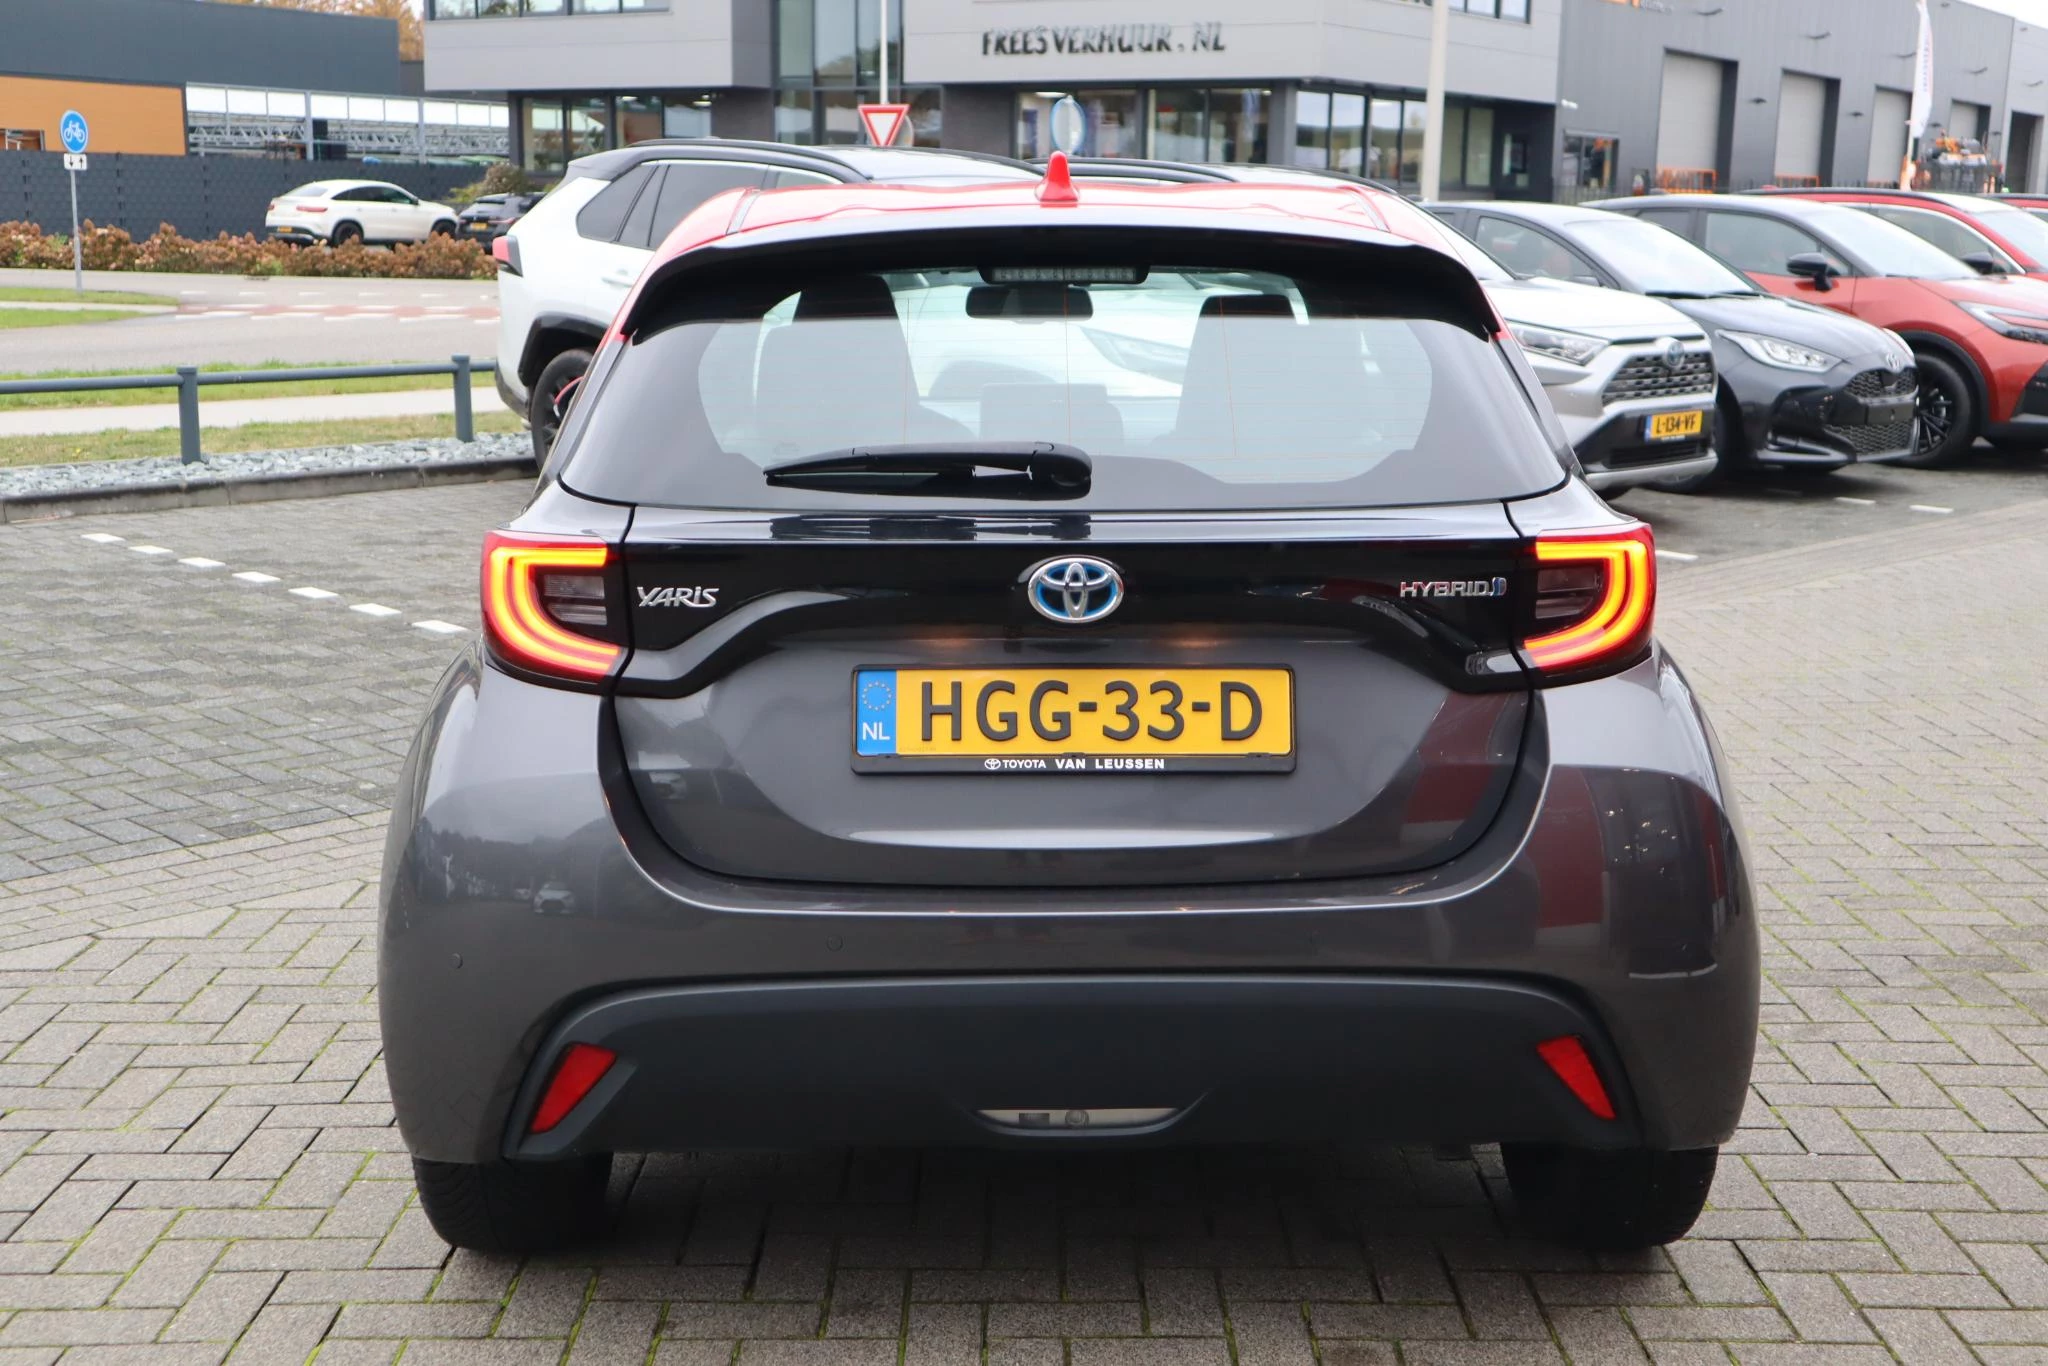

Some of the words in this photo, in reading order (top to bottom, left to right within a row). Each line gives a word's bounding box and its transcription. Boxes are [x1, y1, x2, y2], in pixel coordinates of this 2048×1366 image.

[636, 586, 720, 608] YARIS
[1400, 580, 1490, 598] HYBRID
[921, 680, 1263, 742] HGG-33-D
[862, 721, 891, 741] NL
[1002, 758, 1047, 770] TOYOTA
[1055, 758, 1086, 770] VAN
[1095, 758, 1165, 770] LEUSSEN
